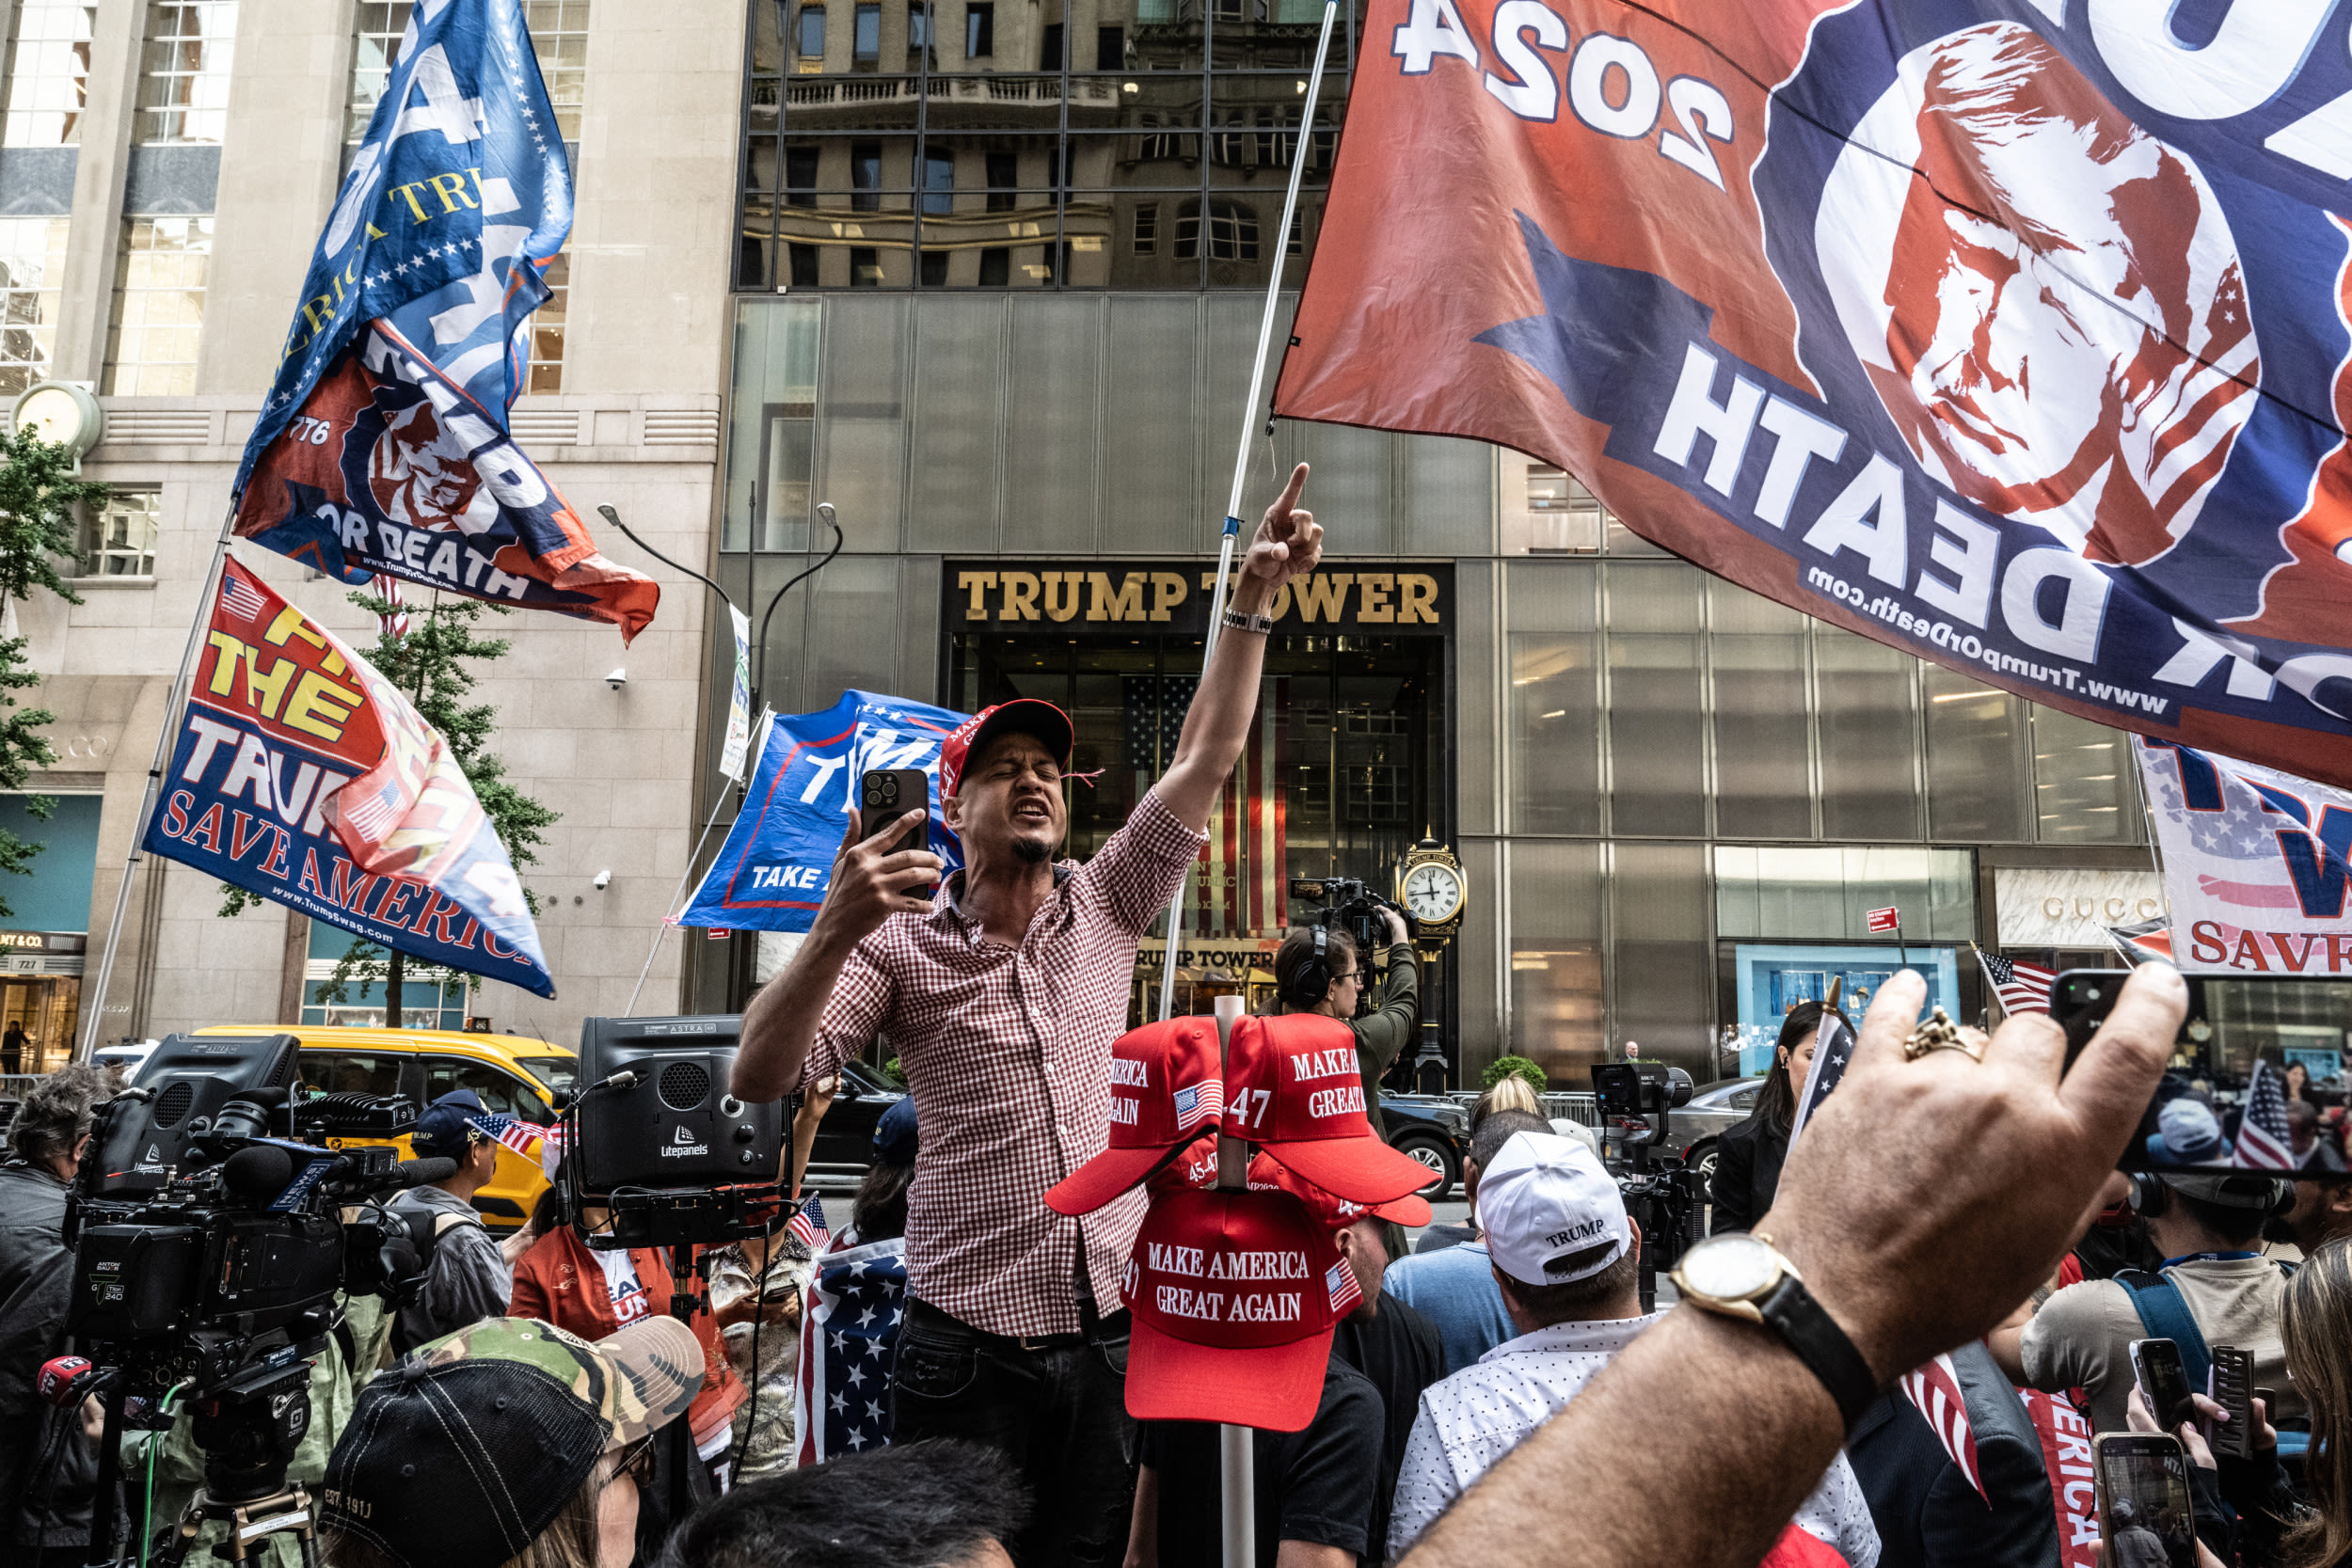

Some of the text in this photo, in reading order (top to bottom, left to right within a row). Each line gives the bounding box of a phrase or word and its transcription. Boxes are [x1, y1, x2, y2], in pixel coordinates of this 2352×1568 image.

[377, 520, 531, 600] DEATH
[958, 571, 1188, 623] TRUMP
[208, 628, 365, 744] THE
[949, 711, 989, 743] MAKE
[161, 789, 292, 881] SAVE
[752, 865, 822, 889] TAKE
[271, 884, 394, 944] www.TrumpSwag.com
[670, 1024, 704, 1033] ASTRA
[1290, 1049, 1351, 1083] MAKE
[1309, 1087, 1361, 1119] GREAT
[660, 1144, 708, 1158] Litepanels
[1546, 1219, 1604, 1248] TRUMP
[1148, 1242, 1311, 1281] MAKE AMERICA
[1156, 1285, 1302, 1323] GREAT AGAIN
